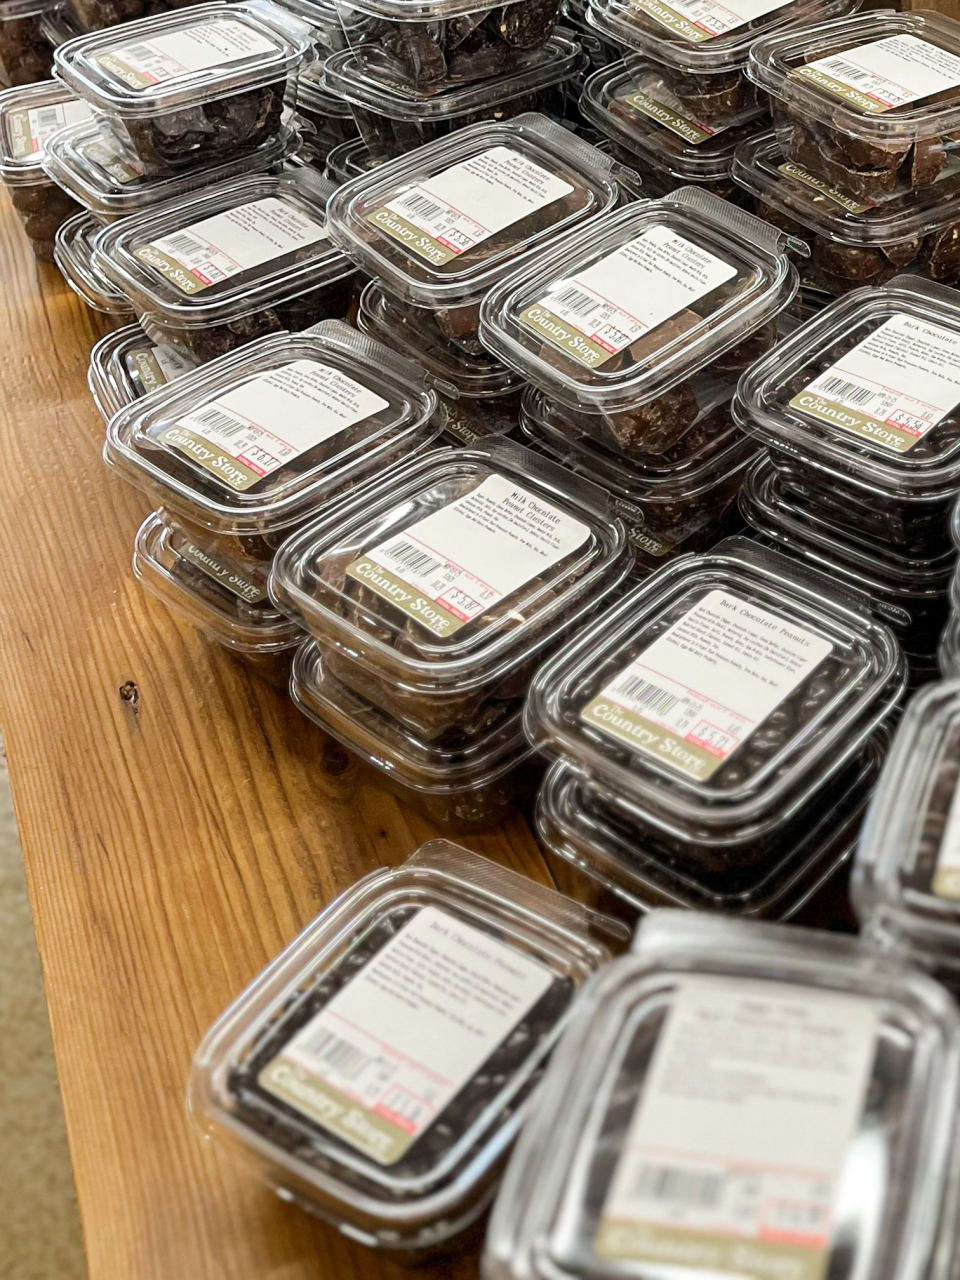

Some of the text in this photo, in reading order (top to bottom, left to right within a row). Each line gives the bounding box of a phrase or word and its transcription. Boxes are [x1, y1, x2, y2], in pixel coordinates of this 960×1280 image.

[675, 20, 704, 41] Store
[99, 56, 144, 89] Country Store
[800, 68, 846, 98] Country
[845, 90, 879, 110] Store
[633, 95, 701, 141] Country Store
[12, 113, 26, 154] Country Store
[112, 162, 128, 180] Store
[503, 158, 545, 186] Peanut Clusters
[512, 157, 551, 181] Milk Chocolate
[785, 163, 828, 188] Country
[287, 213, 310, 229] Chocolate
[375, 211, 446, 260] Country Store
[662, 241, 706, 270] Peanut Clusters
[671, 238, 713, 265] Milk Chocolate
[138, 248, 172, 274] Country
[170, 267, 196, 291] Store
[542, 309, 552, 318] The
[527, 308, 601, 361] Country Store
[922, 328, 958, 345] Chocolate
[135, 352, 157, 387] Country
[309, 369, 357, 399] Peanut Clusters
[333, 373, 362, 395] Chocolate
[814, 396, 827, 406] The
[799, 396, 906, 446] Country Store
[895, 412, 905, 423] $
[164, 428, 248, 484] Country Store
[501, 497, 556, 533] Peanut Clusters
[510, 491, 562, 526] Milk Chocolate
[628, 528, 663, 551] Store
[371, 564, 384, 575] The
[355, 563, 450, 629] Country Store
[451, 589, 481, 613] $ 5.87
[719, 599, 811, 648] Dark Chocolate Peanuts
[610, 703, 625, 716] The
[592, 703, 707, 768] Country Store
[698, 725, 730, 751] $ 5.71
[270, 1063, 394, 1151] Country Store
